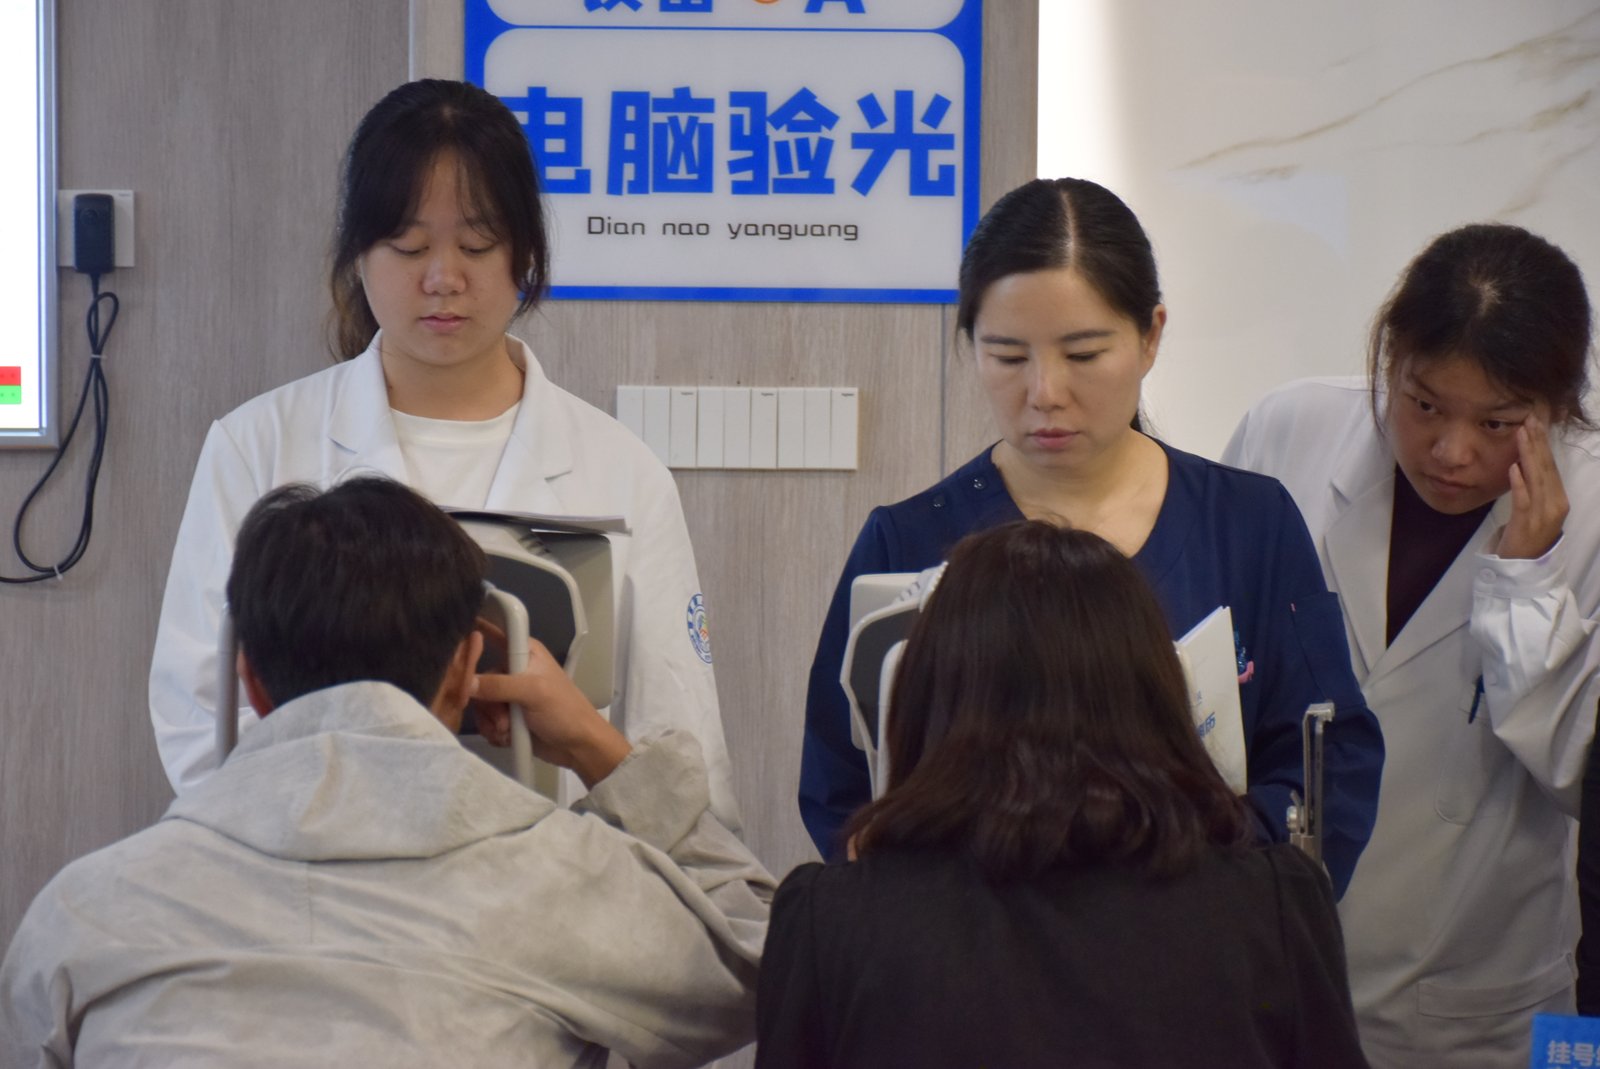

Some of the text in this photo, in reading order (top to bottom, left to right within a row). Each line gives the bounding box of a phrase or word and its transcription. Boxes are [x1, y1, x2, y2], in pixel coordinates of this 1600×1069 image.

[497, 86, 956, 197] 电脑验光
[587, 216, 859, 241] Dian nao yanguang
[1547, 1040, 1600, 1067] 挂号
